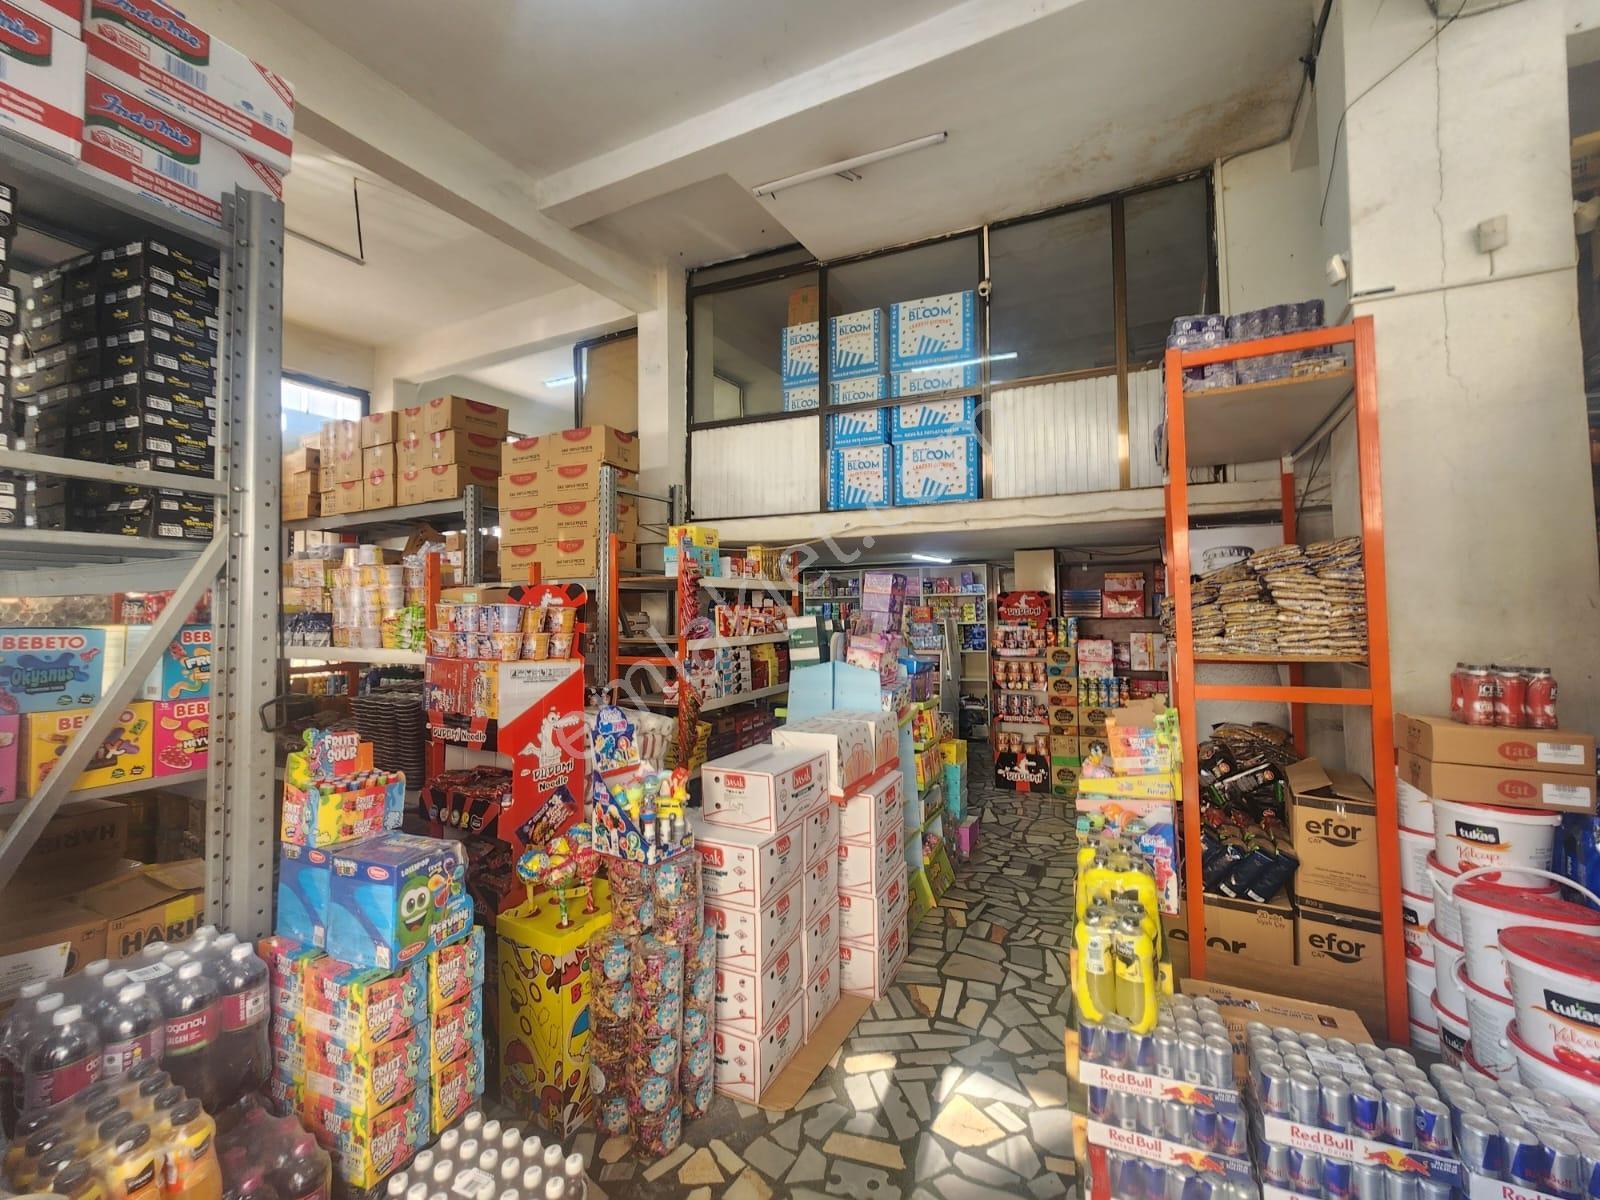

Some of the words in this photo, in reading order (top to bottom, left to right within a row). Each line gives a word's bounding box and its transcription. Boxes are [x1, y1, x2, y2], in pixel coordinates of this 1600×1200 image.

[908, 305, 952, 322] BLOOM
[840, 324, 872, 336] BLOOM
[909, 379, 953, 393] BLOOM
[842, 391, 875, 402] BLOOM
[912, 449, 955, 463] BLOOM
[847, 461, 880, 471] BLOOM
[2, 636, 85, 650] BEBETO
[10, 666, 76, 688] Okyanus
[324, 733, 360, 749] FRUIT
[461, 731, 487, 743] Noodle
[327, 747, 358, 763] SOUR
[1505, 743, 1531, 758] tat
[538, 776, 569, 792] Noodle
[1504, 782, 1530, 796] tat
[1305, 818, 1362, 841] efor
[703, 848, 722, 866] sak
[401, 858, 430, 877] LOLLIPOP
[428, 909, 469, 936] PERVANE
[1308, 933, 1366, 957] efor
[437, 956, 461, 978] FRUIT
[438, 969, 460, 988] SOUR
[366, 994, 398, 1020] FRUIT
[368, 1009, 394, 1031] SOUR
[435, 1018, 460, 1041] FRUIT
[325, 1041, 344, 1054] FRUIT
[436, 1031, 458, 1051] SOUR
[326, 1052, 343, 1065] SOUR
[372, 1054, 402, 1080] FRUIT
[373, 1069, 399, 1094] SOUR
[439, 1073, 463, 1097] FRUIT
[1100, 1068, 1126, 1084] Red
[1127, 1074, 1153, 1089] Bull
[440, 1086, 461, 1109] SOUR
[370, 1122, 401, 1149] FRUIT
[1108, 1129, 1135, 1145] Red
[1136, 1136, 1163, 1152] Bull
[1290, 1125, 1321, 1143] Red
[1323, 1133, 1354, 1151] Bull
[371, 1137, 398, 1163] SOUR
